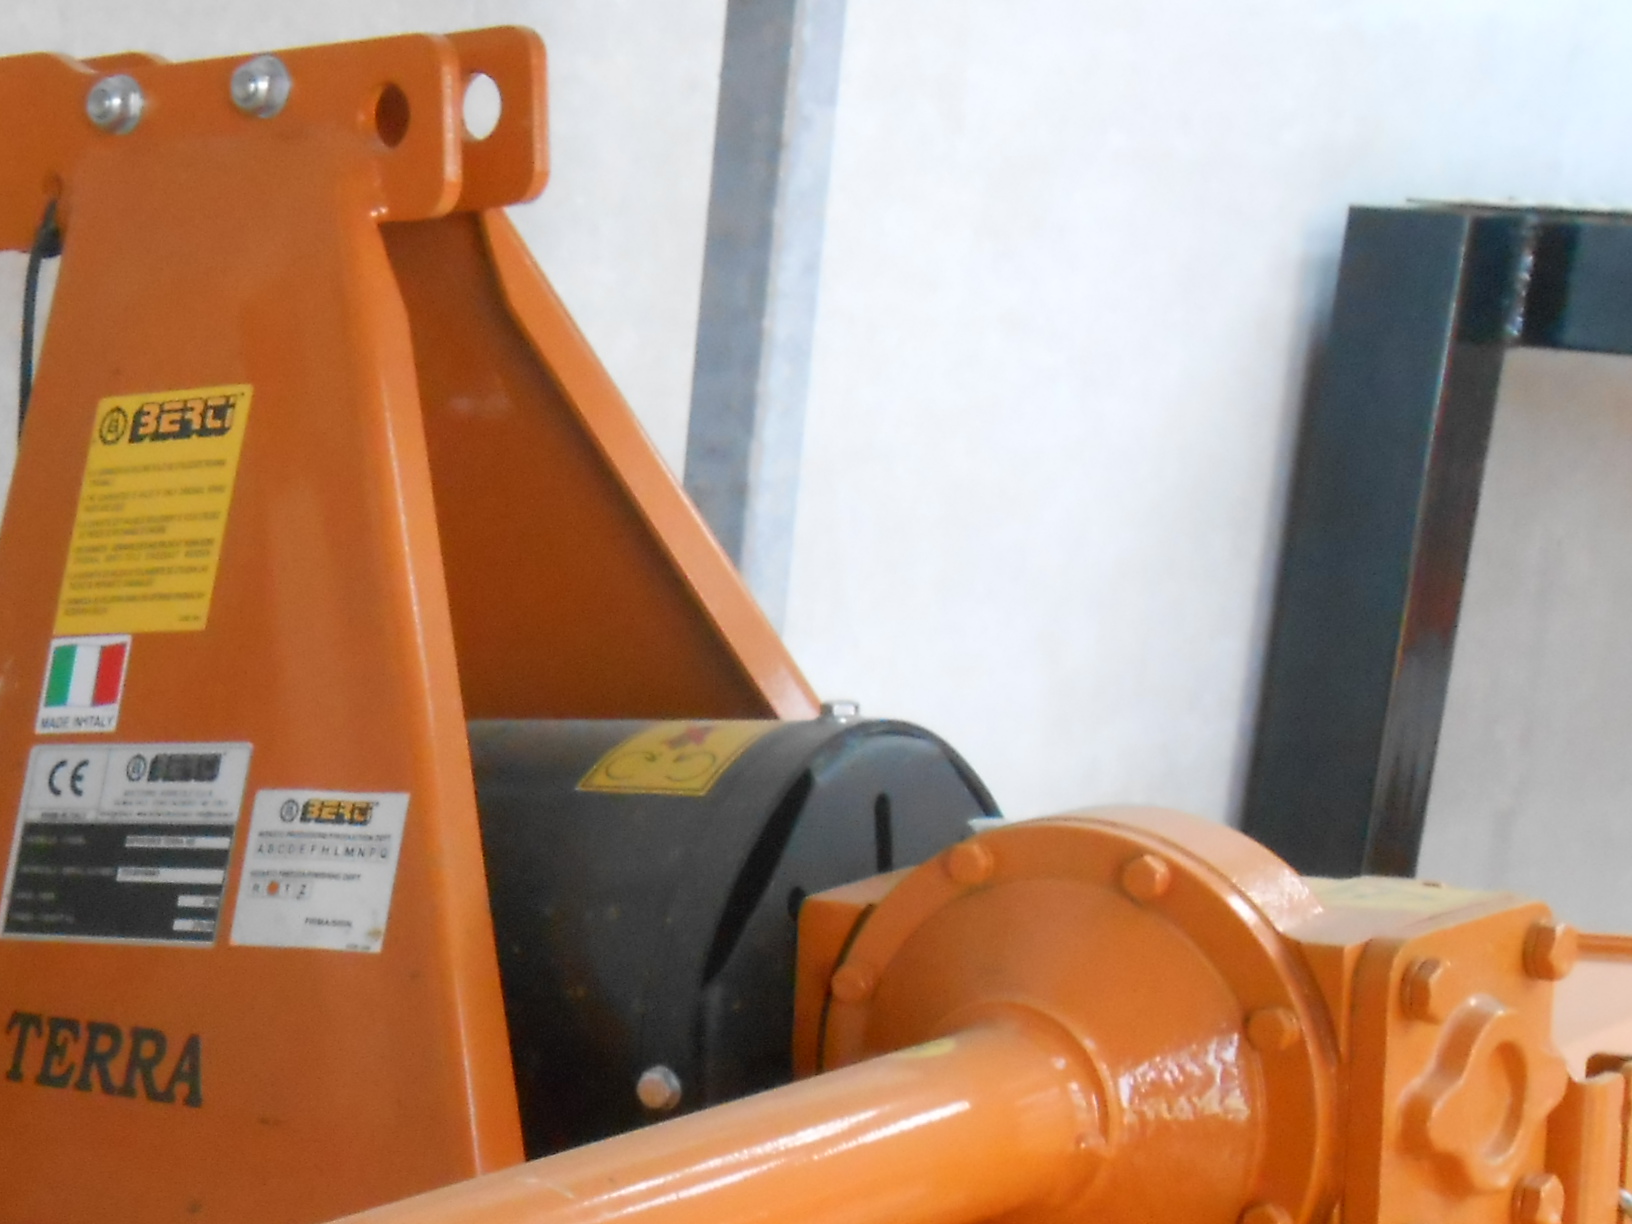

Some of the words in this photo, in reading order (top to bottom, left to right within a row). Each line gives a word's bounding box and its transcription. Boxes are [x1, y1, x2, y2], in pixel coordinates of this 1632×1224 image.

[41, 716, 69, 728] MADE
[48, 759, 90, 796] CE
[5, 1010, 203, 1108] TERRA
